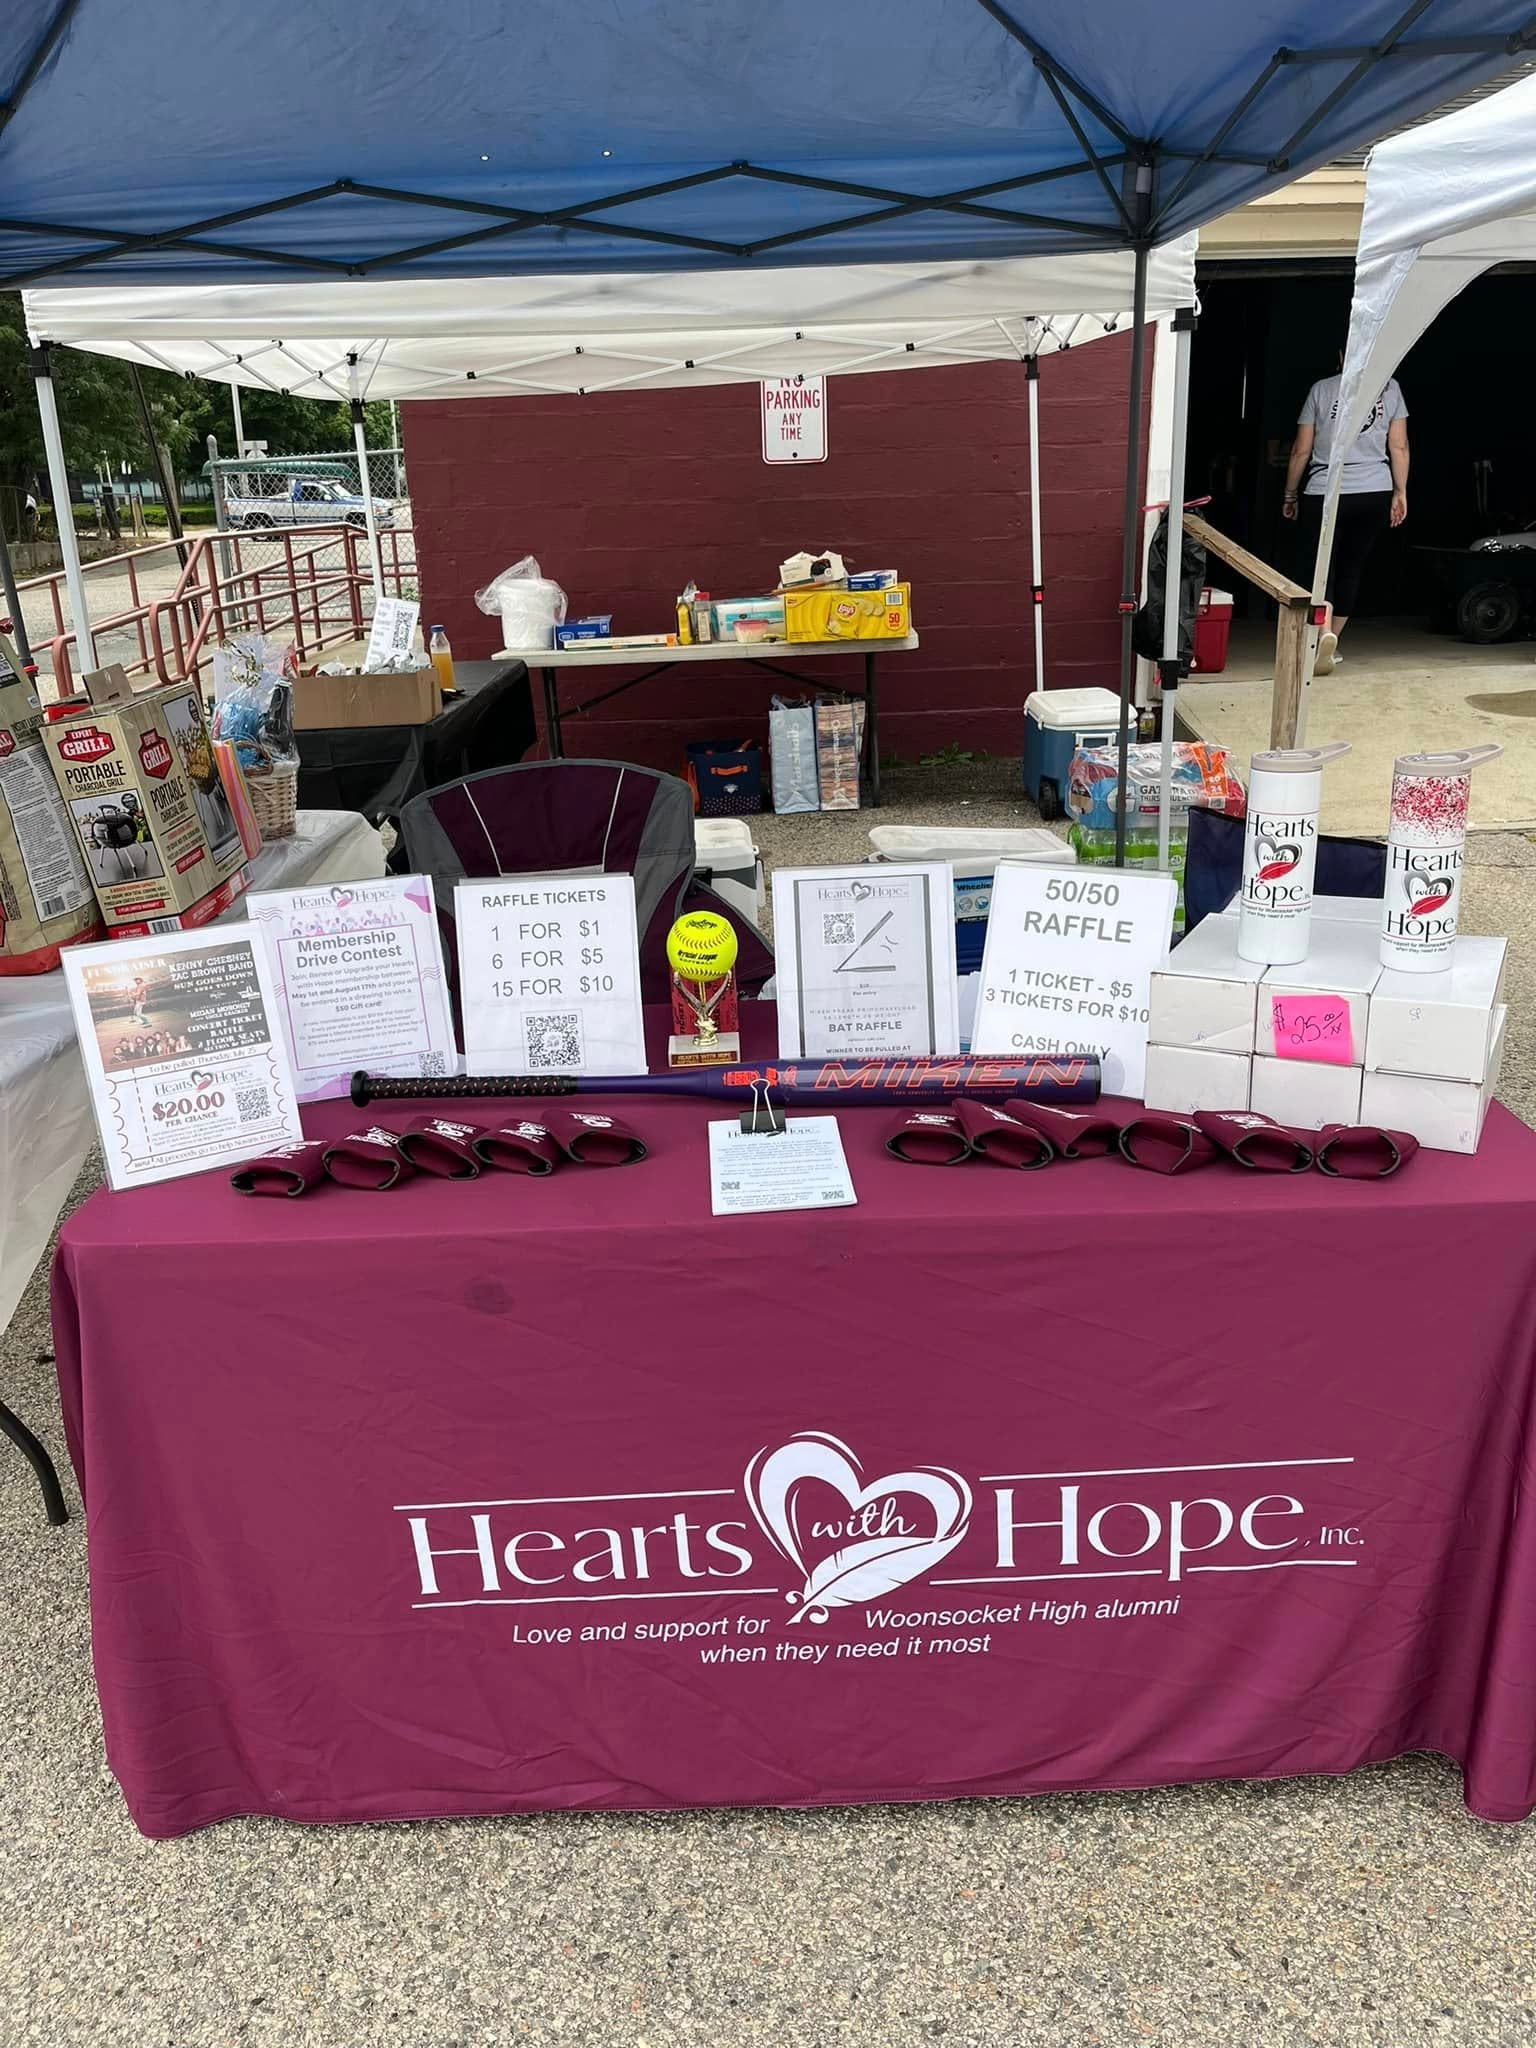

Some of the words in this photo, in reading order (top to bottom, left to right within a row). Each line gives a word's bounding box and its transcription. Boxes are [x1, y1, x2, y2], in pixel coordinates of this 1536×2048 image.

[766, 390, 821, 409] PARKING
[782, 413, 802, 426] ANY
[780, 427, 803, 440] TIME
[888, 612, 900, 624] 50
[63, 737, 111, 757] GRILL
[142, 743, 171, 771] GRILL
[64, 760, 127, 785] PORTABLE
[75, 781, 107, 793] CHARCOAL
[106, 778, 125, 788] GRILL
[150, 775, 187, 813] PORTABLE
[1247, 812, 1315, 837] Hearts
[1263, 850, 1290, 862] with
[1392, 846, 1465, 872] Hearts
[292, 895, 331, 910] Hearts
[355, 889, 391, 903] Hope
[481, 892, 540, 908] RAFFLE
[543, 889, 607, 905] TICKETS
[818, 888, 851, 901] Hearts
[872, 886, 903, 899] Hope
[1045, 878, 1120, 906] 50/50
[1242, 874, 1304, 908] Hope
[1415, 884, 1443, 896] with
[491, 926, 500, 941] 1
[519, 922, 563, 940] FOR
[579, 919, 601, 937] $1
[1023, 911, 1134, 944] RAFFLE
[1387, 910, 1455, 943] Hope
[297, 931, 396, 953] Membership
[169, 959, 204, 973] KENNY
[207, 951, 252, 966] CHESNEY
[296, 952, 337, 968] Drive
[341, 945, 403, 963] Contest
[344, 964, 374, 976] Upgrade
[375, 962, 392, 970] your
[392, 959, 414, 968] Hearts
[492, 954, 504, 970] 6
[521, 950, 565, 968] FOR
[580, 948, 604, 965] $5
[170, 968, 190, 982] ZAC
[191, 964, 226, 978] BROWN
[228, 960, 254, 972] BAND
[195, 976, 224, 987] GOES
[225, 970, 254, 983] DOWN
[297, 981, 313, 989] with
[334, 972, 380, 985] membership
[381, 969, 412, 978] between
[292, 992, 307, 1000] May
[334, 985, 361, 995] August
[378, 981, 392, 989] and
[392, 980, 406, 989] you
[491, 982, 514, 997] 15
[519, 978, 563, 996] FOR
[579, 975, 614, 993] $10
[1008, 968, 1017, 983] 1
[1023, 970, 1094, 993] TICKET
[1110, 981, 1133, 1000] $5
[355, 992, 384, 1002] drawing
[985, 988, 996, 1001] 3
[1001, 989, 1073, 1013] TICKETS
[1078, 1000, 1114, 1018] FOR
[1118, 1006, 1150, 1024] $10
[187, 1019, 228, 1033] CONCERT
[231, 1013, 263, 1026] TICKET
[210, 1025, 245, 1038] RAFFLE
[828, 1022, 853, 1033] BAT
[856, 1021, 902, 1032] RAFFLE
[206, 1034, 236, 1048] FLOOR
[237, 1029, 266, 1041] SEATS
[1011, 1033, 1060, 1052] CASH
[1064, 1041, 1111, 1061] ONLY
[149, 1065, 160, 1073] To
[160, 1063, 170, 1071] be
[171, 1057, 195, 1071] pulled
[247, 1046, 256, 1054] 25
[153, 1082, 193, 1096] Hearts
[214, 1069, 248, 1085] Hope
[814, 1060, 1086, 1089] MIKEN
[152, 1091, 225, 1122] $20.00
[165, 1118, 184, 1128] PER
[185, 1111, 219, 1124] CHANCE
[164, 1150, 198, 1163] proceeds
[218, 1141, 234, 1152] help
[407, 1512, 753, 1595] Hearts
[810, 1497, 918, 1539] with
[1318, 1525, 1366, 1547] Inc.
[513, 1623, 573, 1645] Love
[580, 1621, 627, 1642] and
[633, 1618, 730, 1648] support
[736, 1615, 771, 1635] for
[864, 1601, 1022, 1631] Woonsocket
[1028, 1599, 1090, 1629] High
[1094, 1595, 1182, 1621] alumni
[700, 1644, 768, 1665] when
[775, 1641, 829, 1668] they
[835, 1636, 899, 1660] need
[906, 1634, 922, 1656] it
[928, 1632, 992, 1655] most
